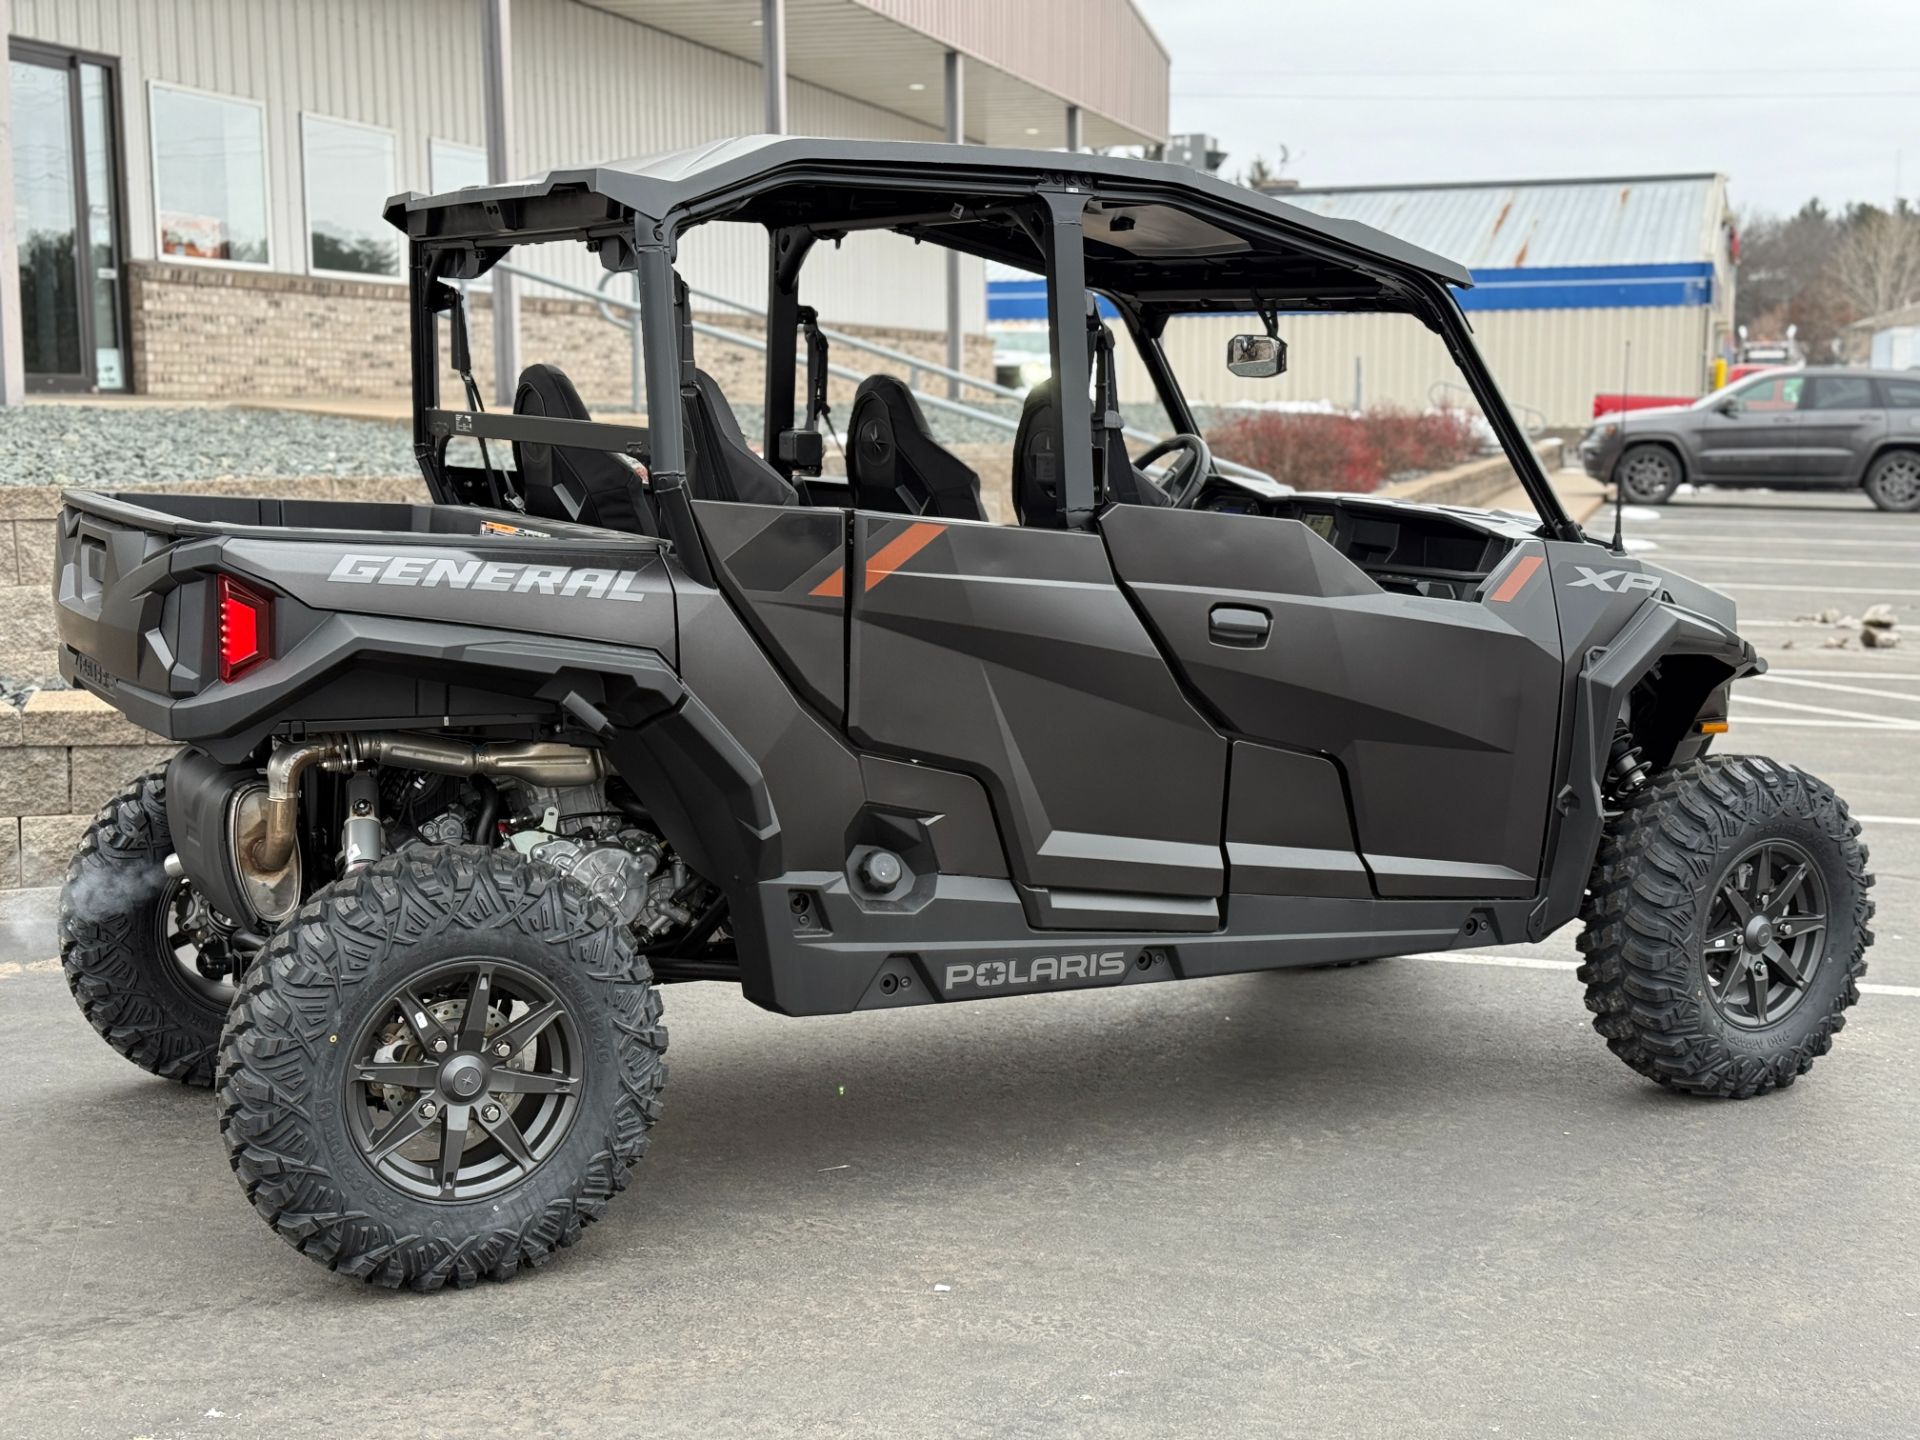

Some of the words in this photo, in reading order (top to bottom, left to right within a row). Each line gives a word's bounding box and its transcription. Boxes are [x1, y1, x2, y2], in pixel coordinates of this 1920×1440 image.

[328, 554, 645, 602] GENERAL
[1565, 565, 1663, 594] XP
[944, 951, 1127, 990] POLARIS
